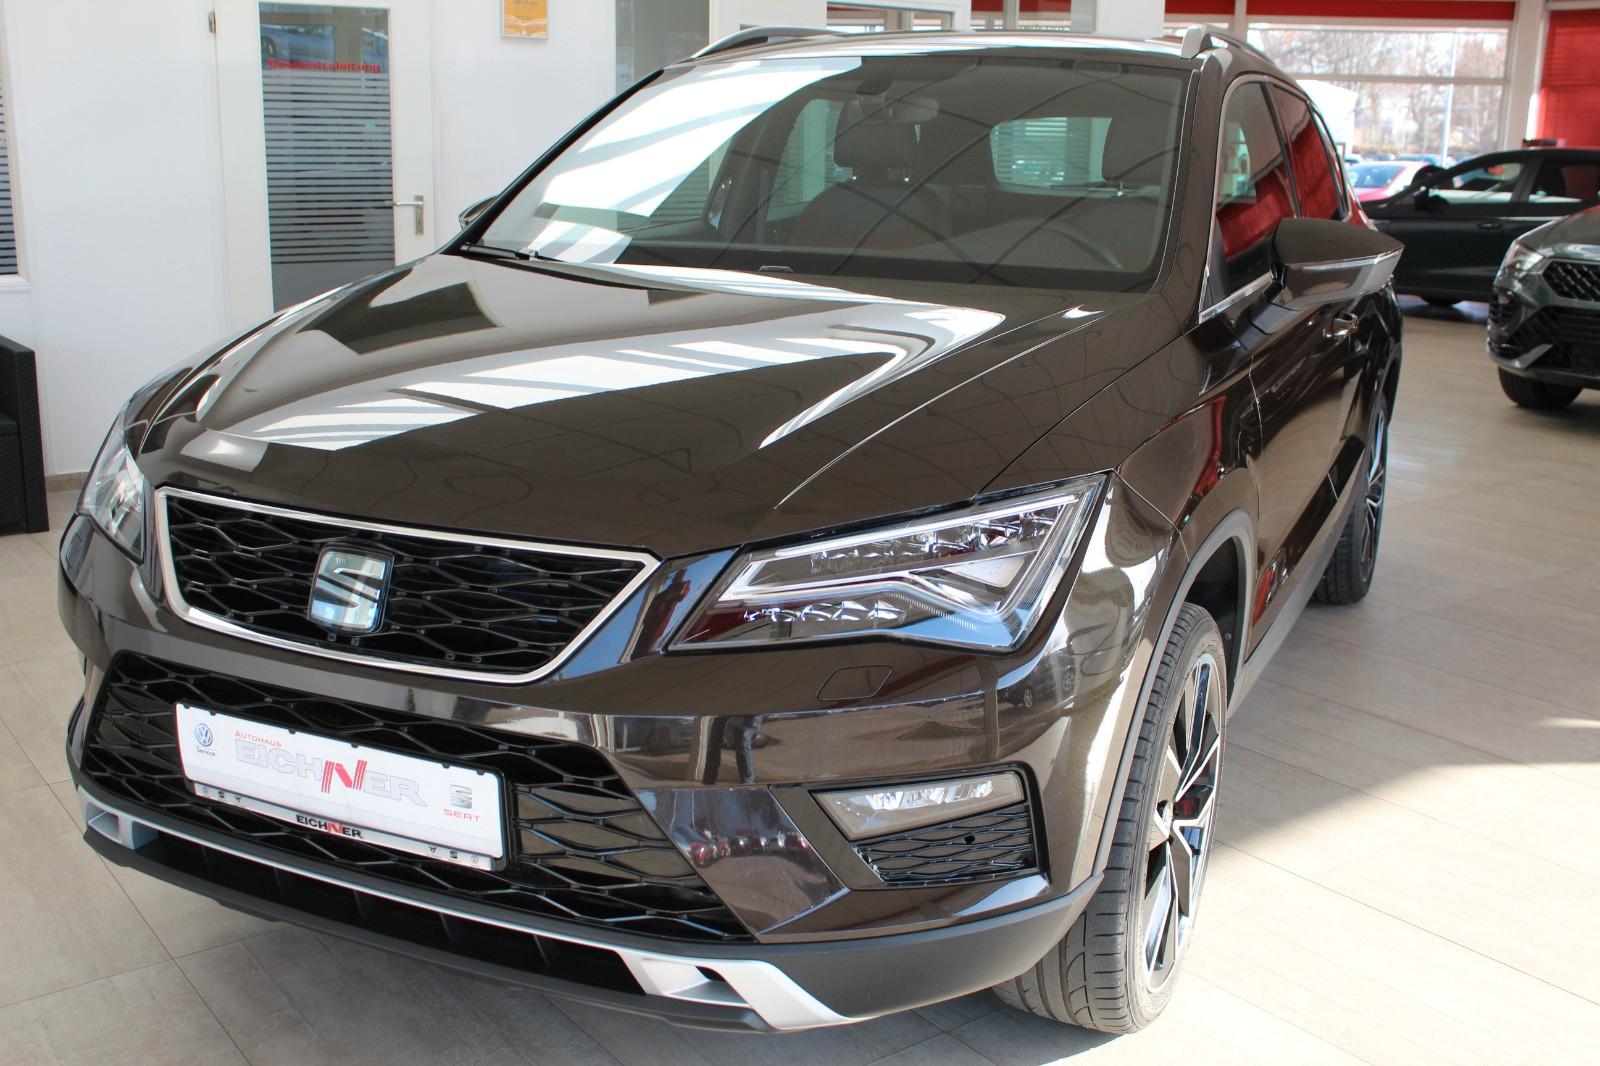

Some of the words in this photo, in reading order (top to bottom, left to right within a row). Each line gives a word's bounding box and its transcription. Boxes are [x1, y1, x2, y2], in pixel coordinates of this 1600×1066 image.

[234, 730, 283, 748] AUTOHAUS
[234, 738, 429, 808] EICHNER
[443, 808, 481, 823] SEAT
[295, 814, 364, 839] EICHNER
